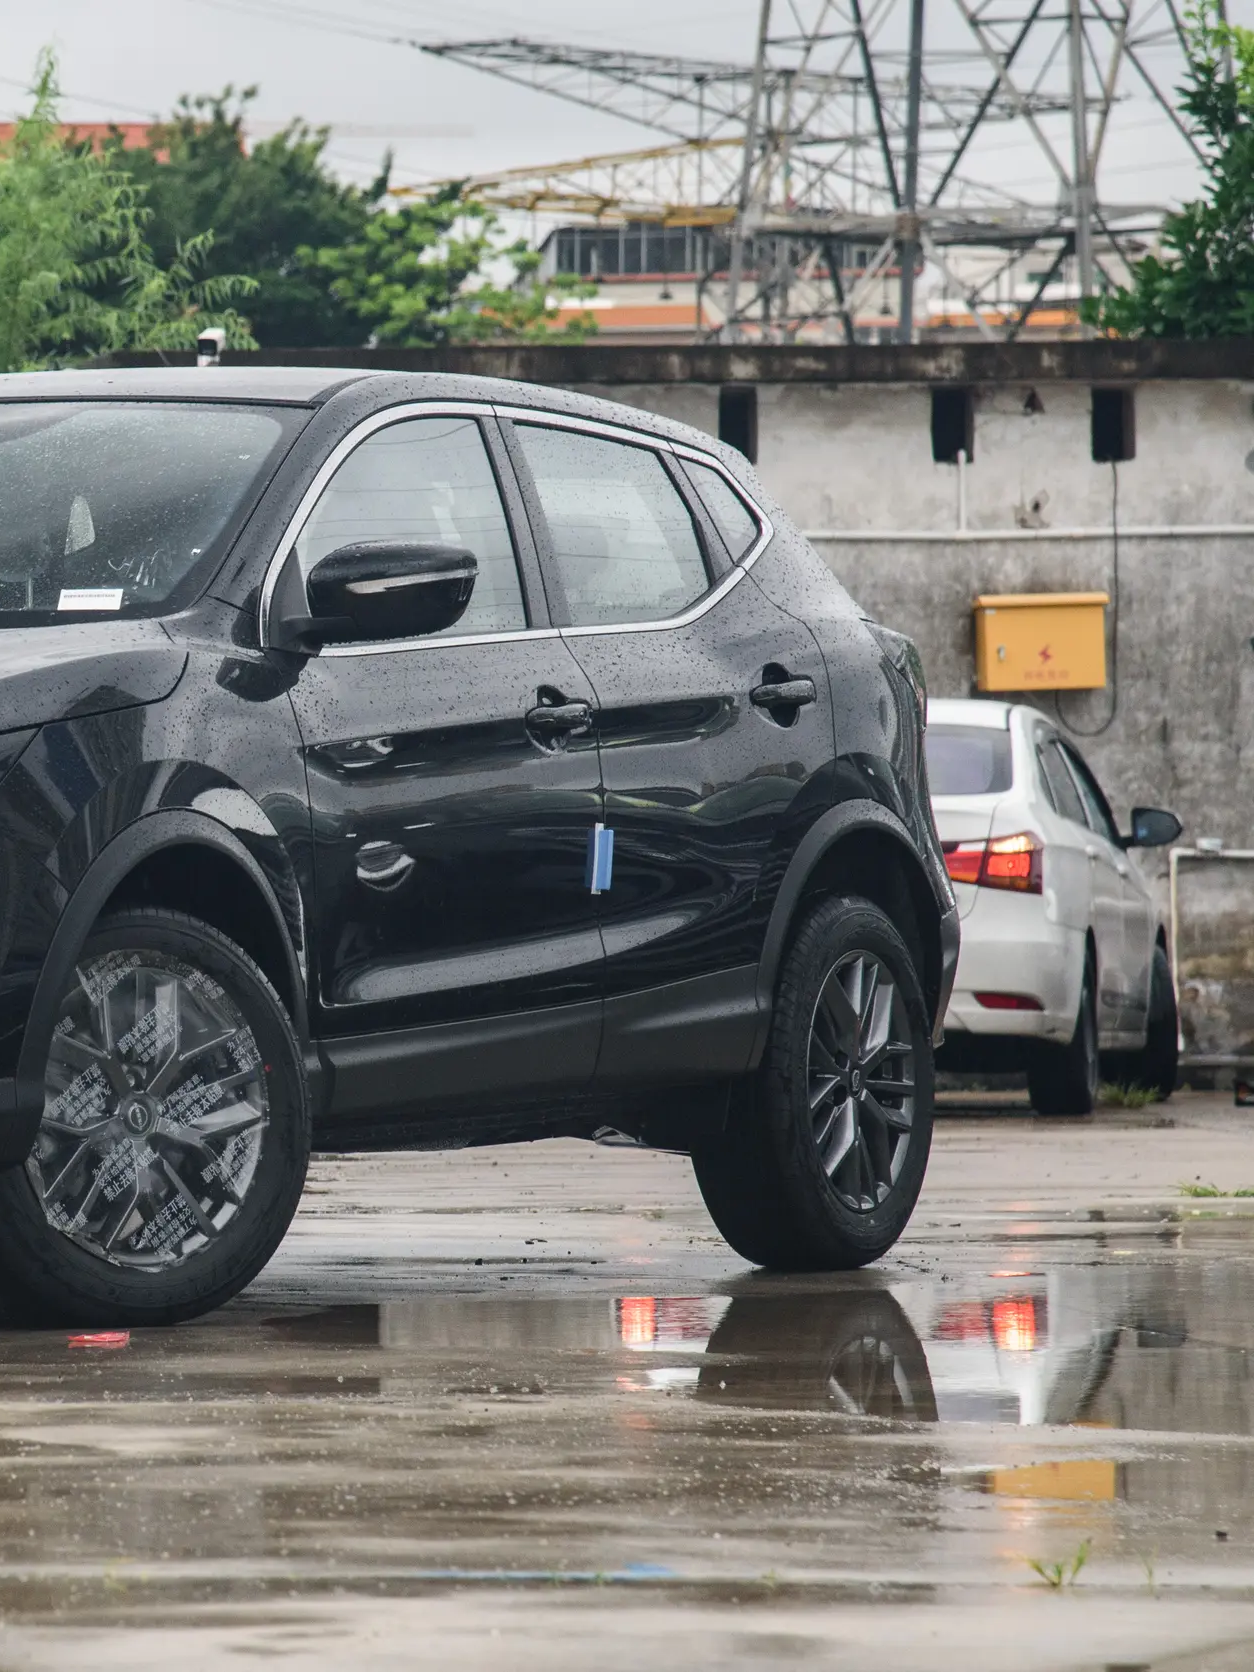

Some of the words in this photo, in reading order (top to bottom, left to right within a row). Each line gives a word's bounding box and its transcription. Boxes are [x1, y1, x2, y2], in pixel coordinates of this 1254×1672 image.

[129, 1191, 187, 1250] 禁止去除本贴
